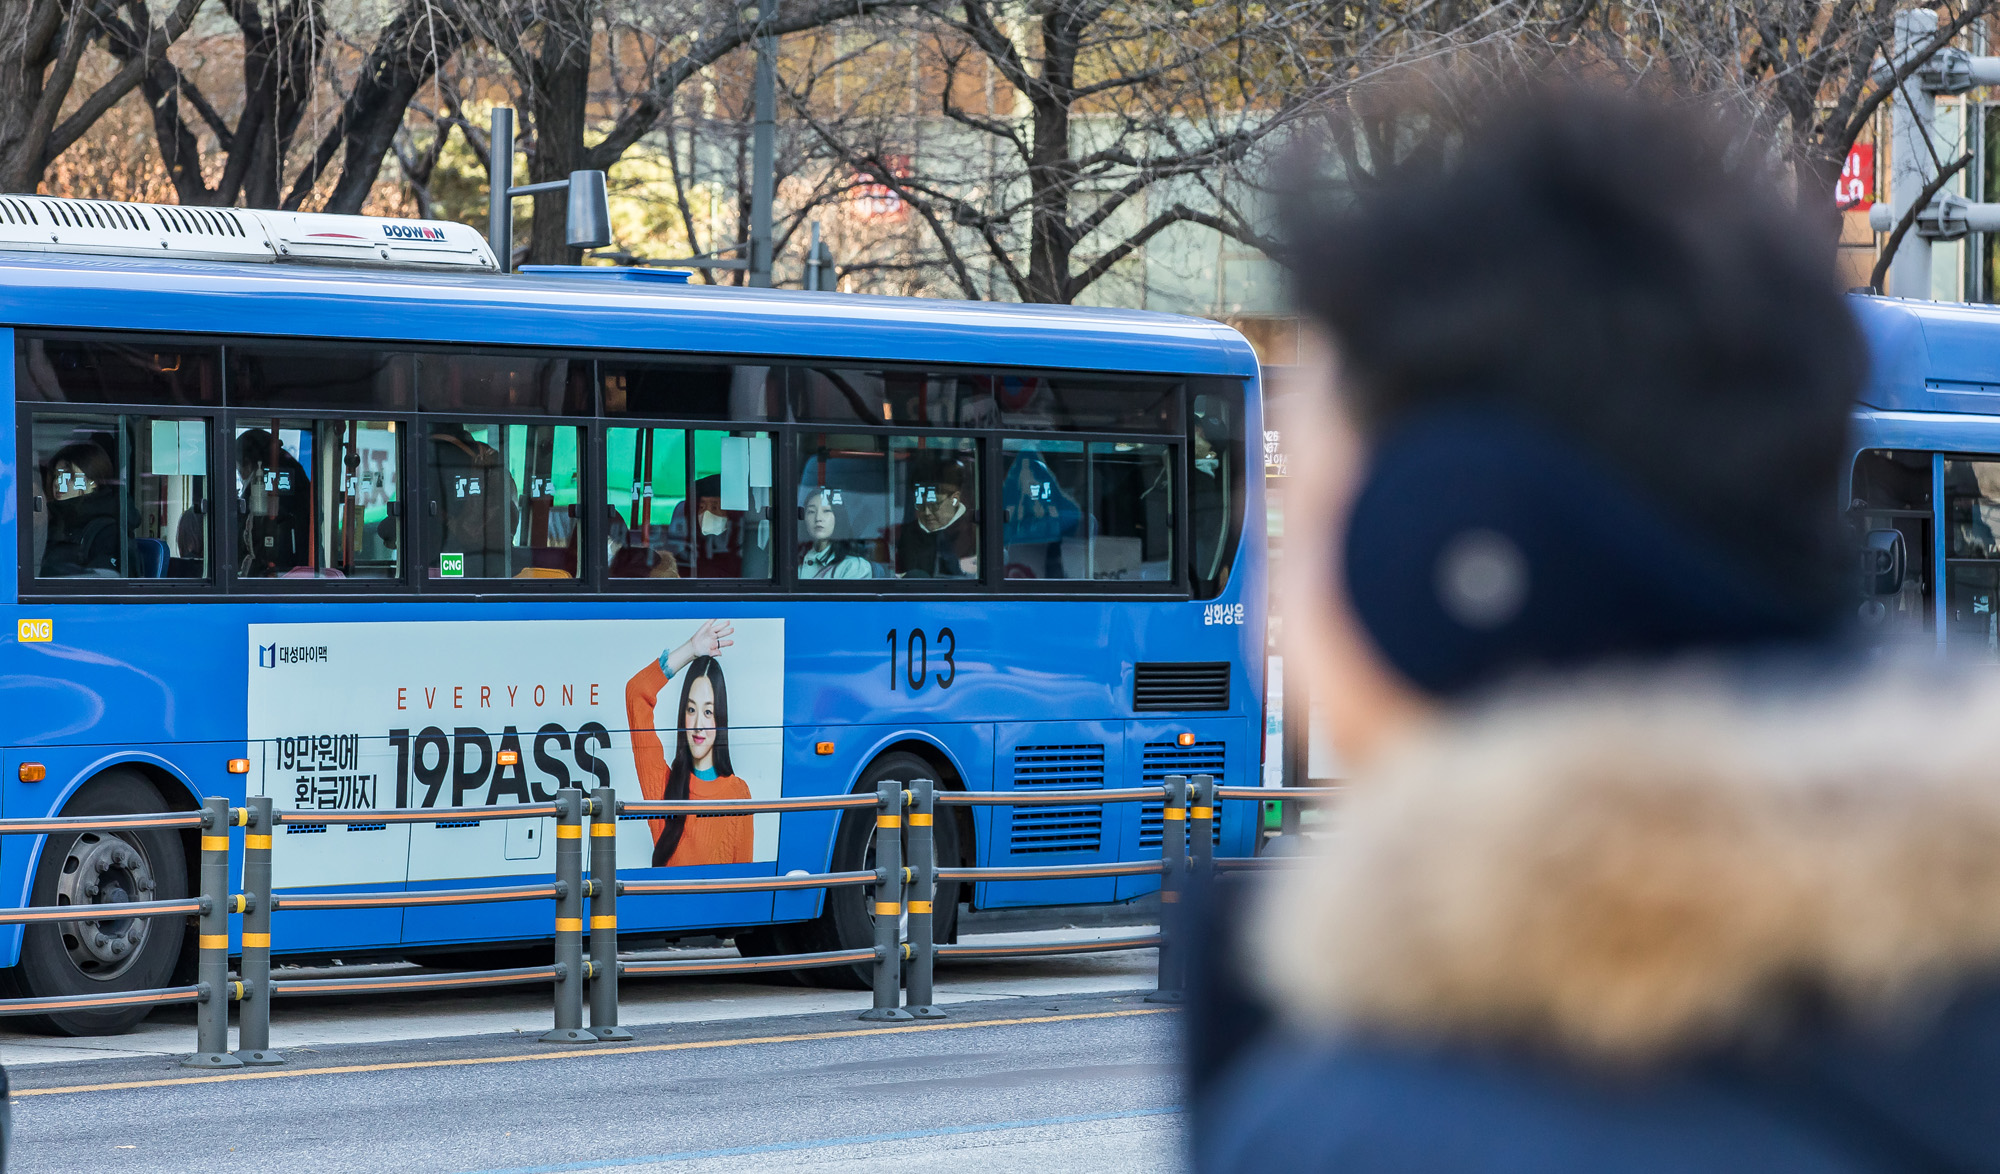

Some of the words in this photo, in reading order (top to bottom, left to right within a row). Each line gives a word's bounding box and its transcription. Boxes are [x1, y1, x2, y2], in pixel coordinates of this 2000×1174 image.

[1835, 178, 1864, 202] LO
[382, 225, 445, 239] DOOWAN
[443, 559, 462, 571] CNG
[1203, 603, 1245, 626] 삼화상운
[20, 622, 50, 640] CNG
[279, 645, 329, 664] 대성마이맥
[886, 626, 956, 691] 103
[397, 683, 600, 711] EVERYONE
[275, 733, 359, 773] 19만원에
[388, 721, 612, 810] 19PASS
[294, 773, 377, 810] 환급까지
